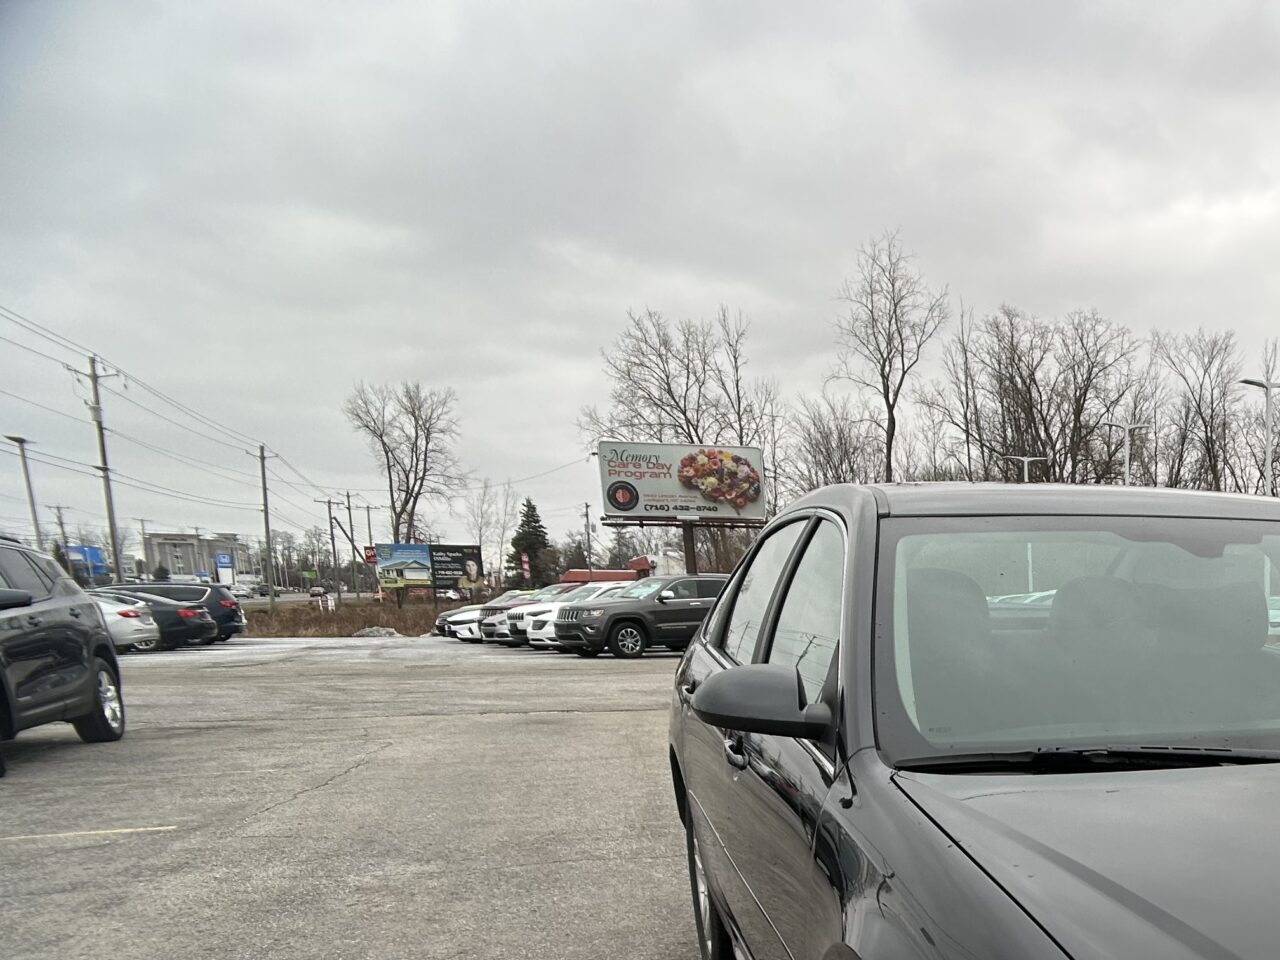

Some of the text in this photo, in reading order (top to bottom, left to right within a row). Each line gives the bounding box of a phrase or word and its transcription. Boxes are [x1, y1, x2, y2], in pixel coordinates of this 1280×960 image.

[602, 448, 661, 465] Memory
[607, 460, 672, 471] Care Day
[608, 469, 672, 480] Program
